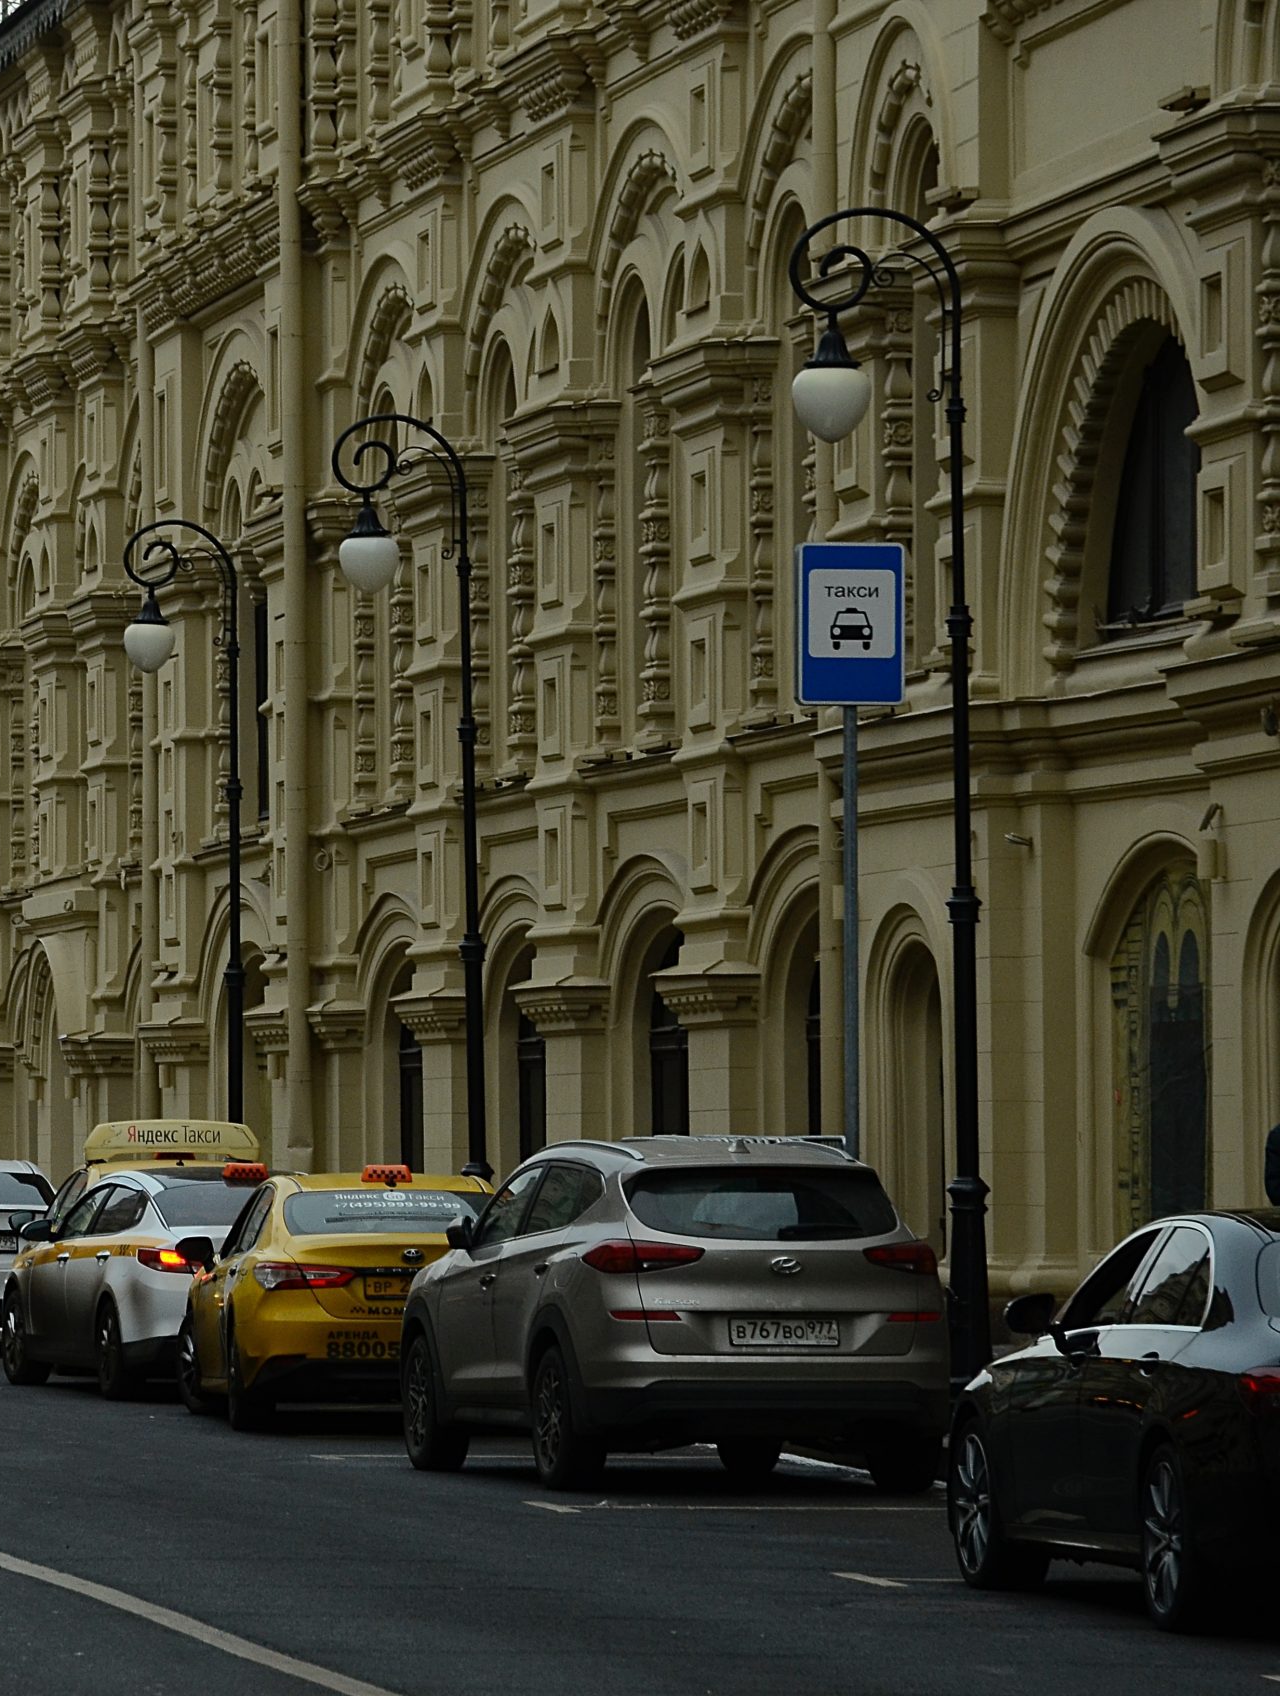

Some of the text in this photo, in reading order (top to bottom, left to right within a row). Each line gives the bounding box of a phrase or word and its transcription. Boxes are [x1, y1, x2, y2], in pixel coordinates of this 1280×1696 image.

[824, 585, 879, 598] такси
[127, 1125, 220, 1145] Яндекс Такси
[327, 1331, 379, 1339] АРЕНДА
[327, 1341, 401, 1359] 88005
